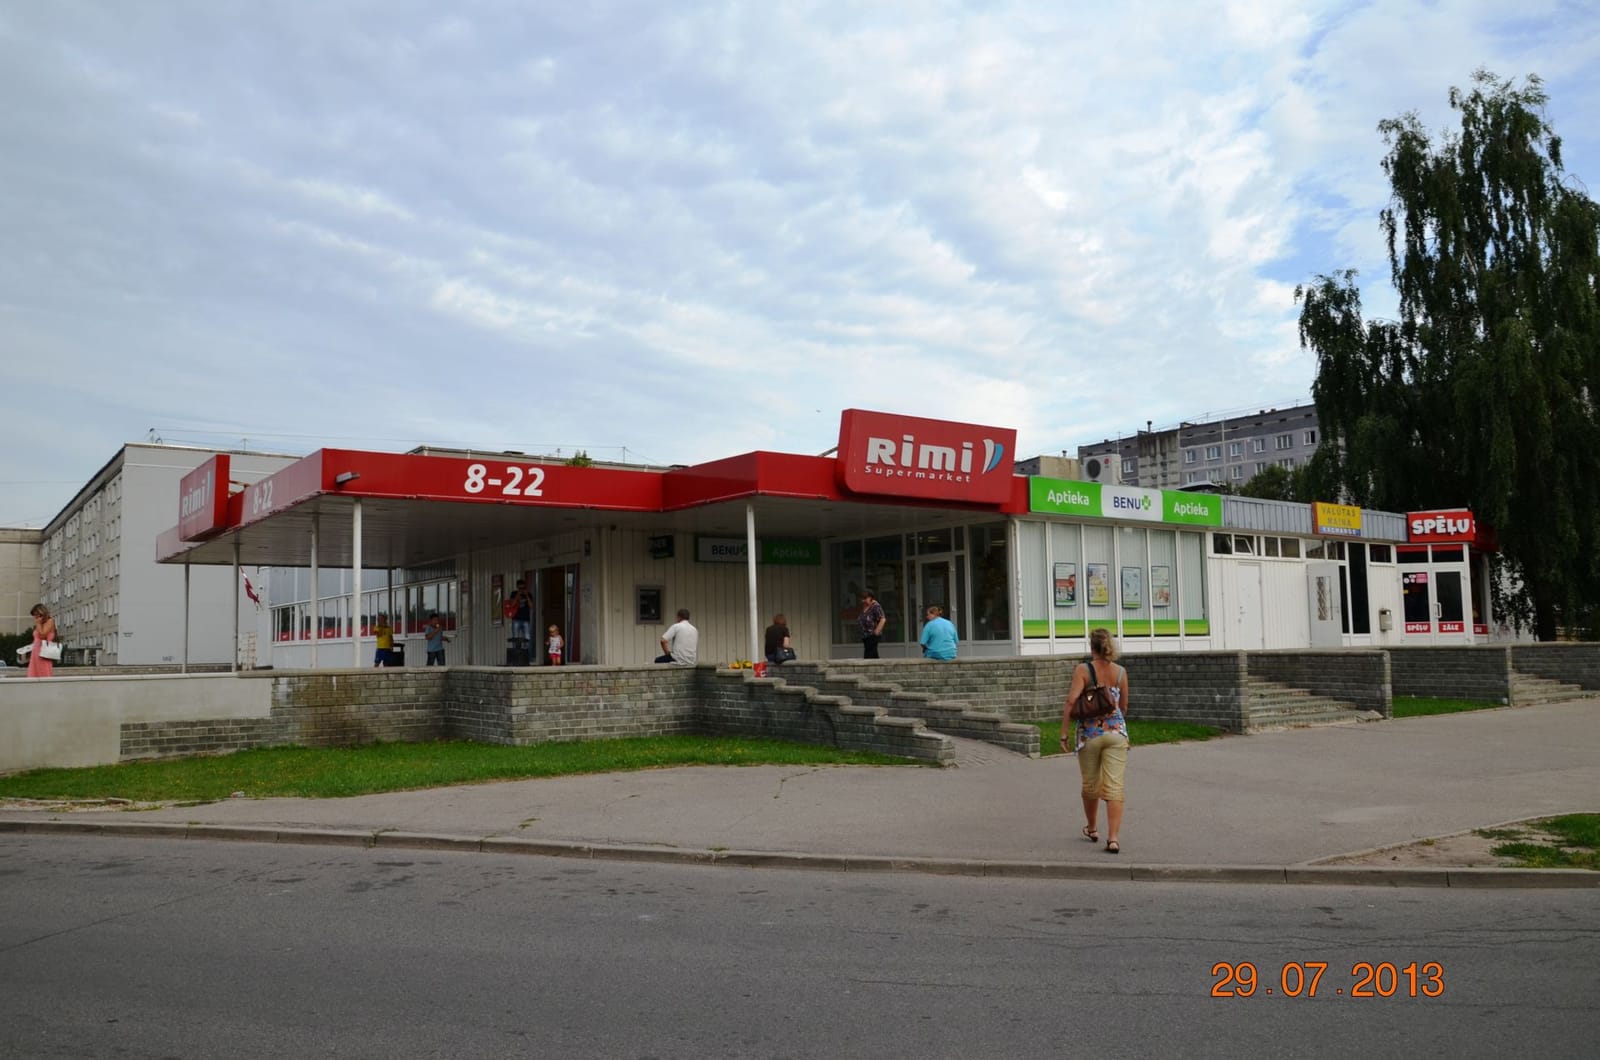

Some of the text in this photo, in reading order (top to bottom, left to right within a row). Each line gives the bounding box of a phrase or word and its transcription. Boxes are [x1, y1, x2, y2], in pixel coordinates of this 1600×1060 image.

[866, 434, 973, 474] Rimi
[464, 463, 545, 497] 8-22
[864, 464, 971, 483] Supermarket
[253, 480, 273, 515] 8-22
[1047, 489, 1090, 506] Aptieka
[1113, 496, 1141, 510] BENU
[1173, 501, 1209, 517] Aptieka
[1412, 516, 1470, 536] SPĒĻU
[711, 544, 739, 556] BENU
